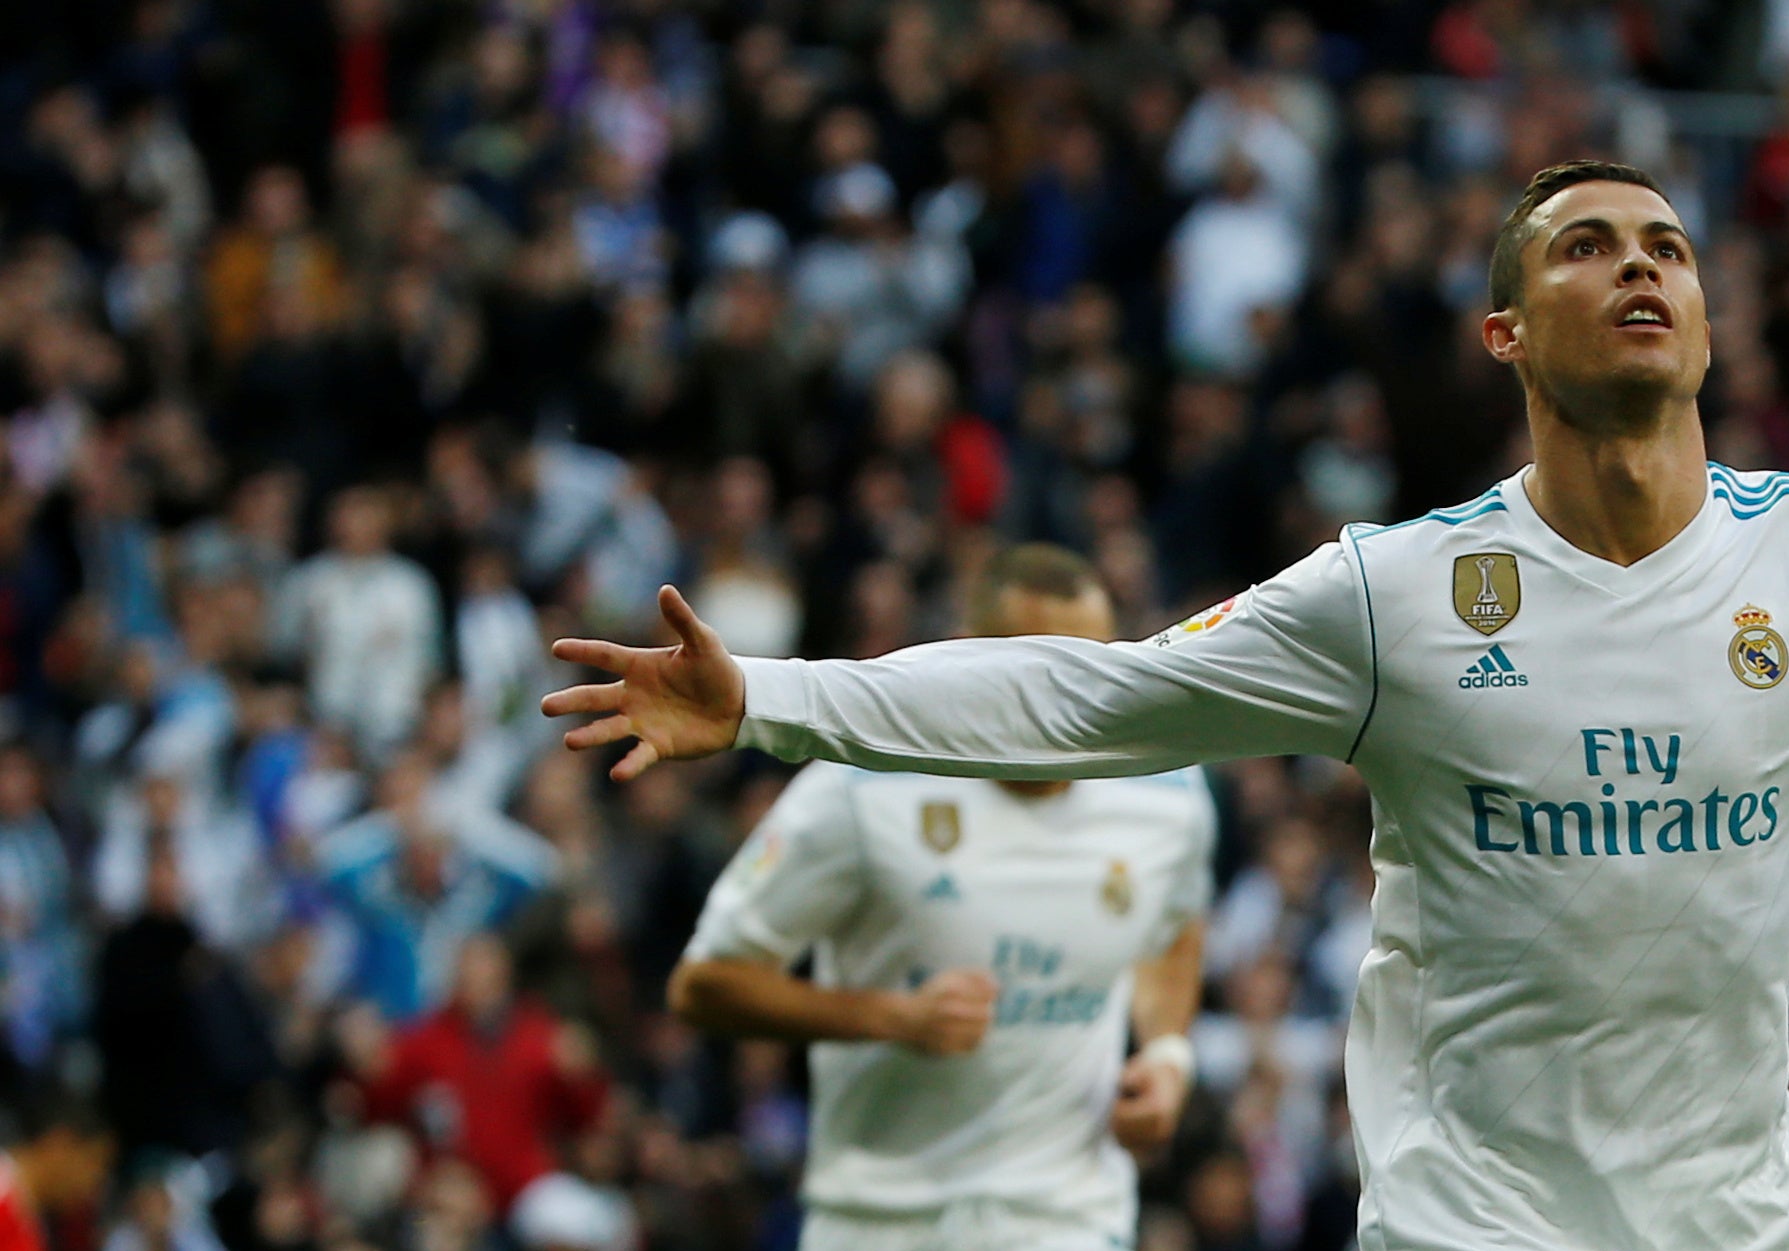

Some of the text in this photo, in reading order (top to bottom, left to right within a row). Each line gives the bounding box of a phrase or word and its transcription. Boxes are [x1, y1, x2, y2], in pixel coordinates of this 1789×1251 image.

[1472, 604, 1504, 616] FIFA
[1458, 672, 1529, 689] adidas
[1580, 728, 1681, 784] Fly
[1463, 783, 1780, 856] Emirates
